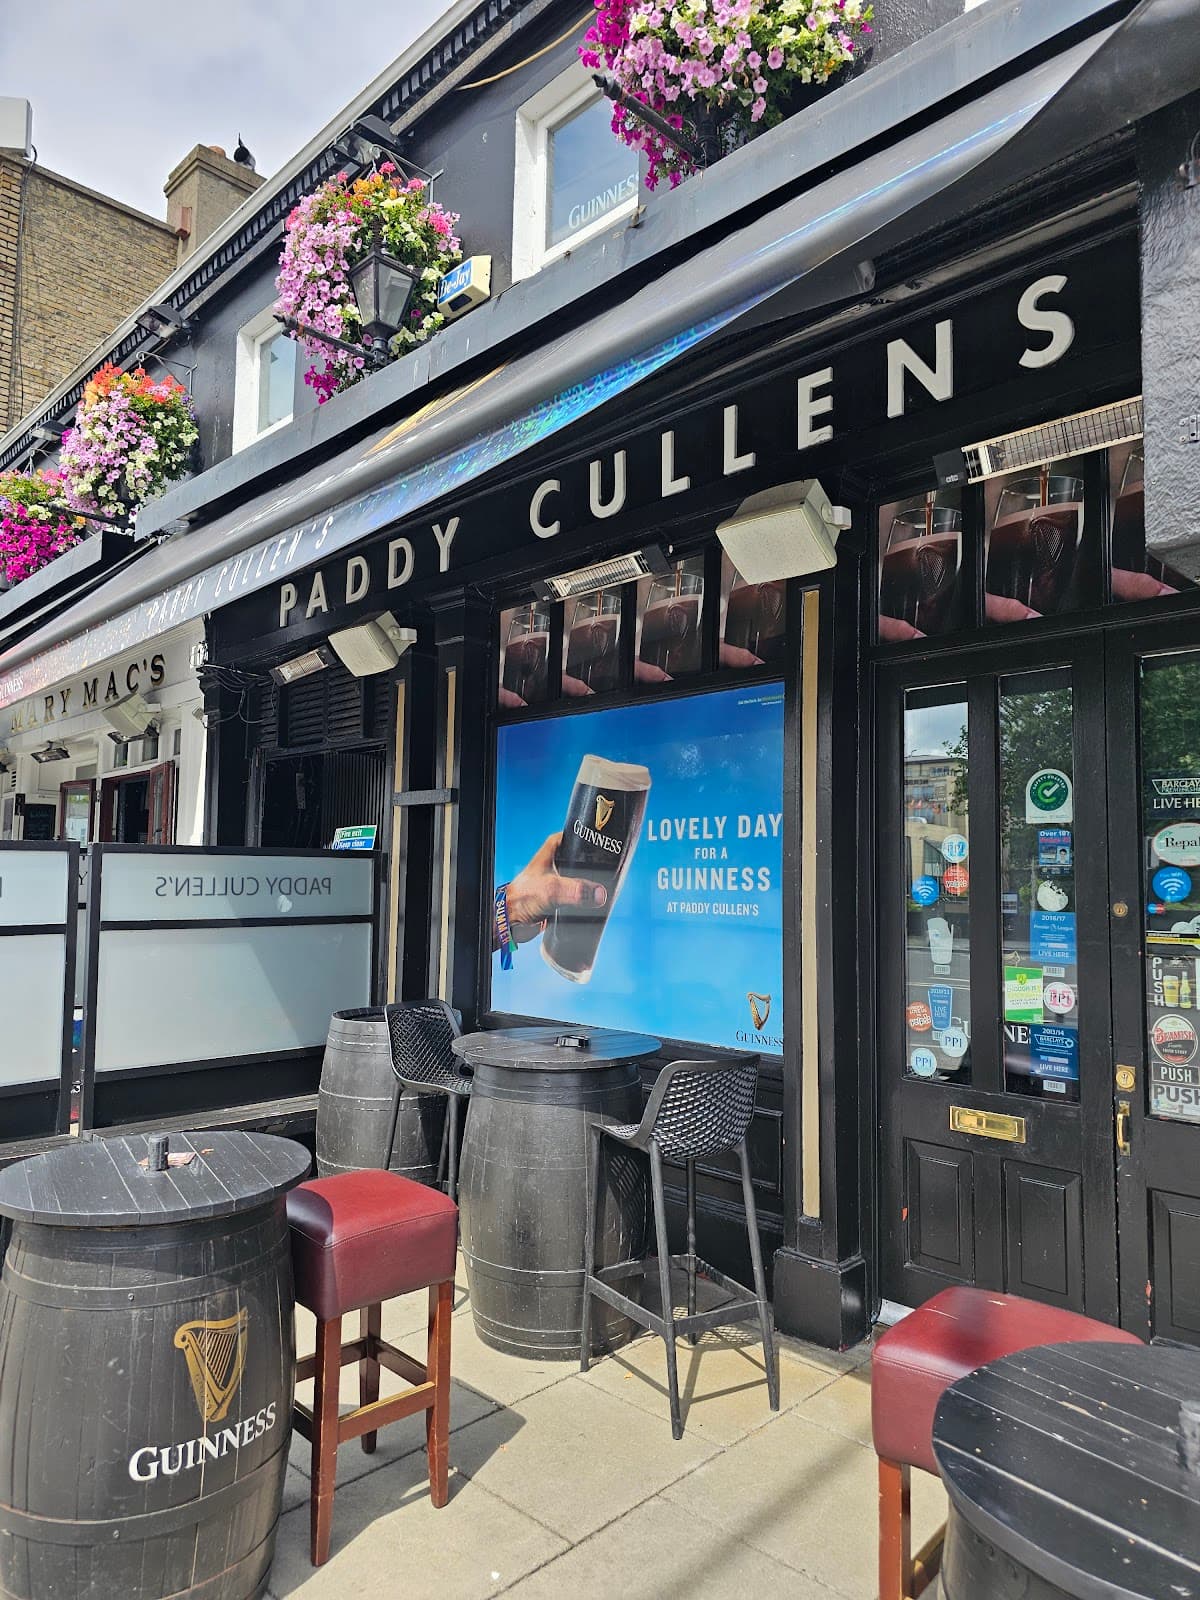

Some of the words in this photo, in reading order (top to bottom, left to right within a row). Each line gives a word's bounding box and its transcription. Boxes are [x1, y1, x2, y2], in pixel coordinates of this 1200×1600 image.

[279, 516, 460, 628] PADDY
[528, 274, 1075, 540] CULLENS
[148, 577, 206, 630] PADDY
[214, 515, 334, 598] CULLEN'S
[10, 688, 72, 733] MARY
[82, 653, 167, 710] MAC'S
[1153, 797, 1182, 809] LIVE
[573, 819, 623, 855] GUINNESS
[647, 815, 728, 842] LOVELY
[737, 813, 783, 840] DAY
[695, 847, 717, 860] FOR
[720, 847, 728, 860] A
[657, 866, 771, 892] GUINNESS
[666, 901, 678, 913] AT
[680, 902, 712, 914] PADDY
[713, 903, 760, 917] CULLEN'S
[1152, 957, 1165, 1006] PUSH
[944, 1035, 963, 1048] PPI
[915, 1056, 932, 1068] PPI
[1039, 1063, 1053, 1071] LIVE
[1053, 1064, 1069, 1073] HERE
[1160, 1066, 1193, 1083] PUSH
[128, 1401, 278, 1482] GUINNESS
